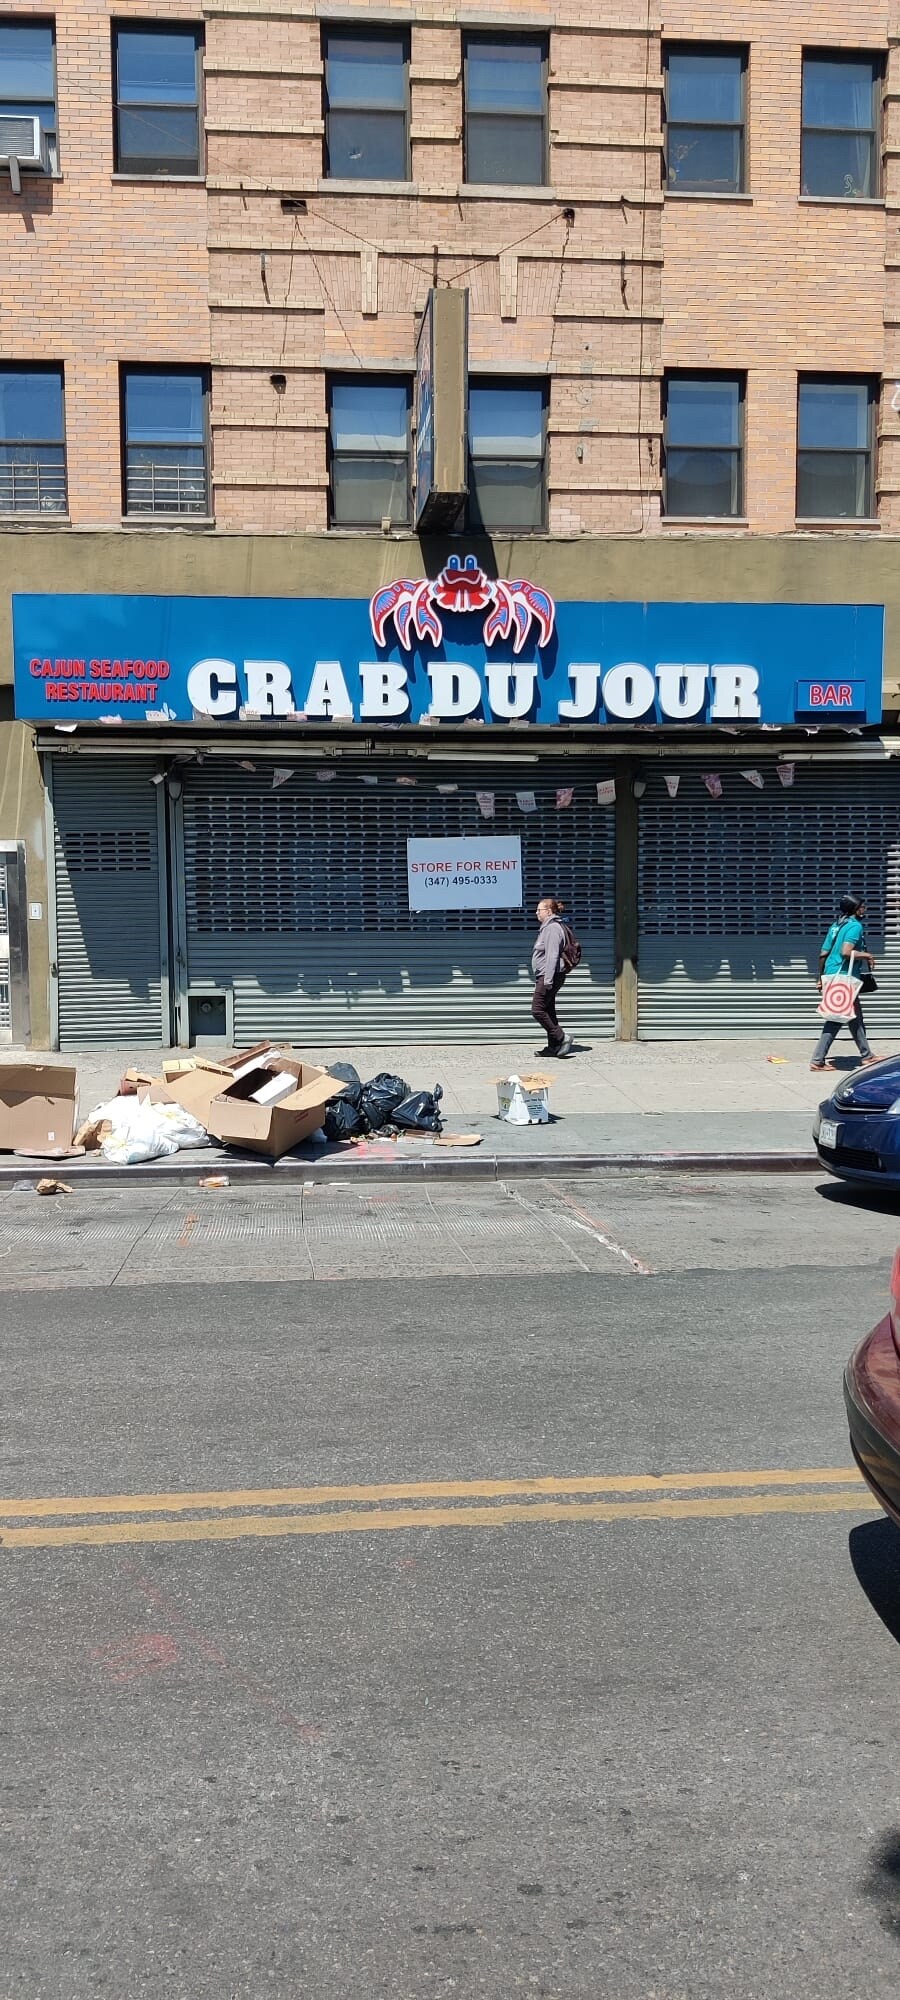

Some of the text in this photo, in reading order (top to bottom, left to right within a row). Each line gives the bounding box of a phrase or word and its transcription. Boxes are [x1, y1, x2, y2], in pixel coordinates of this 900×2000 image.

[29, 658, 170, 680] CAJUN SEAFOOD
[45, 682, 158, 703] RESTAURANT
[187, 658, 761, 719] CRAB DU JOUR
[809, 684, 853, 707] BAR
[411, 860, 518, 873] STORE FOR RENT
[424, 875, 498, 888] (347) 495-0333
